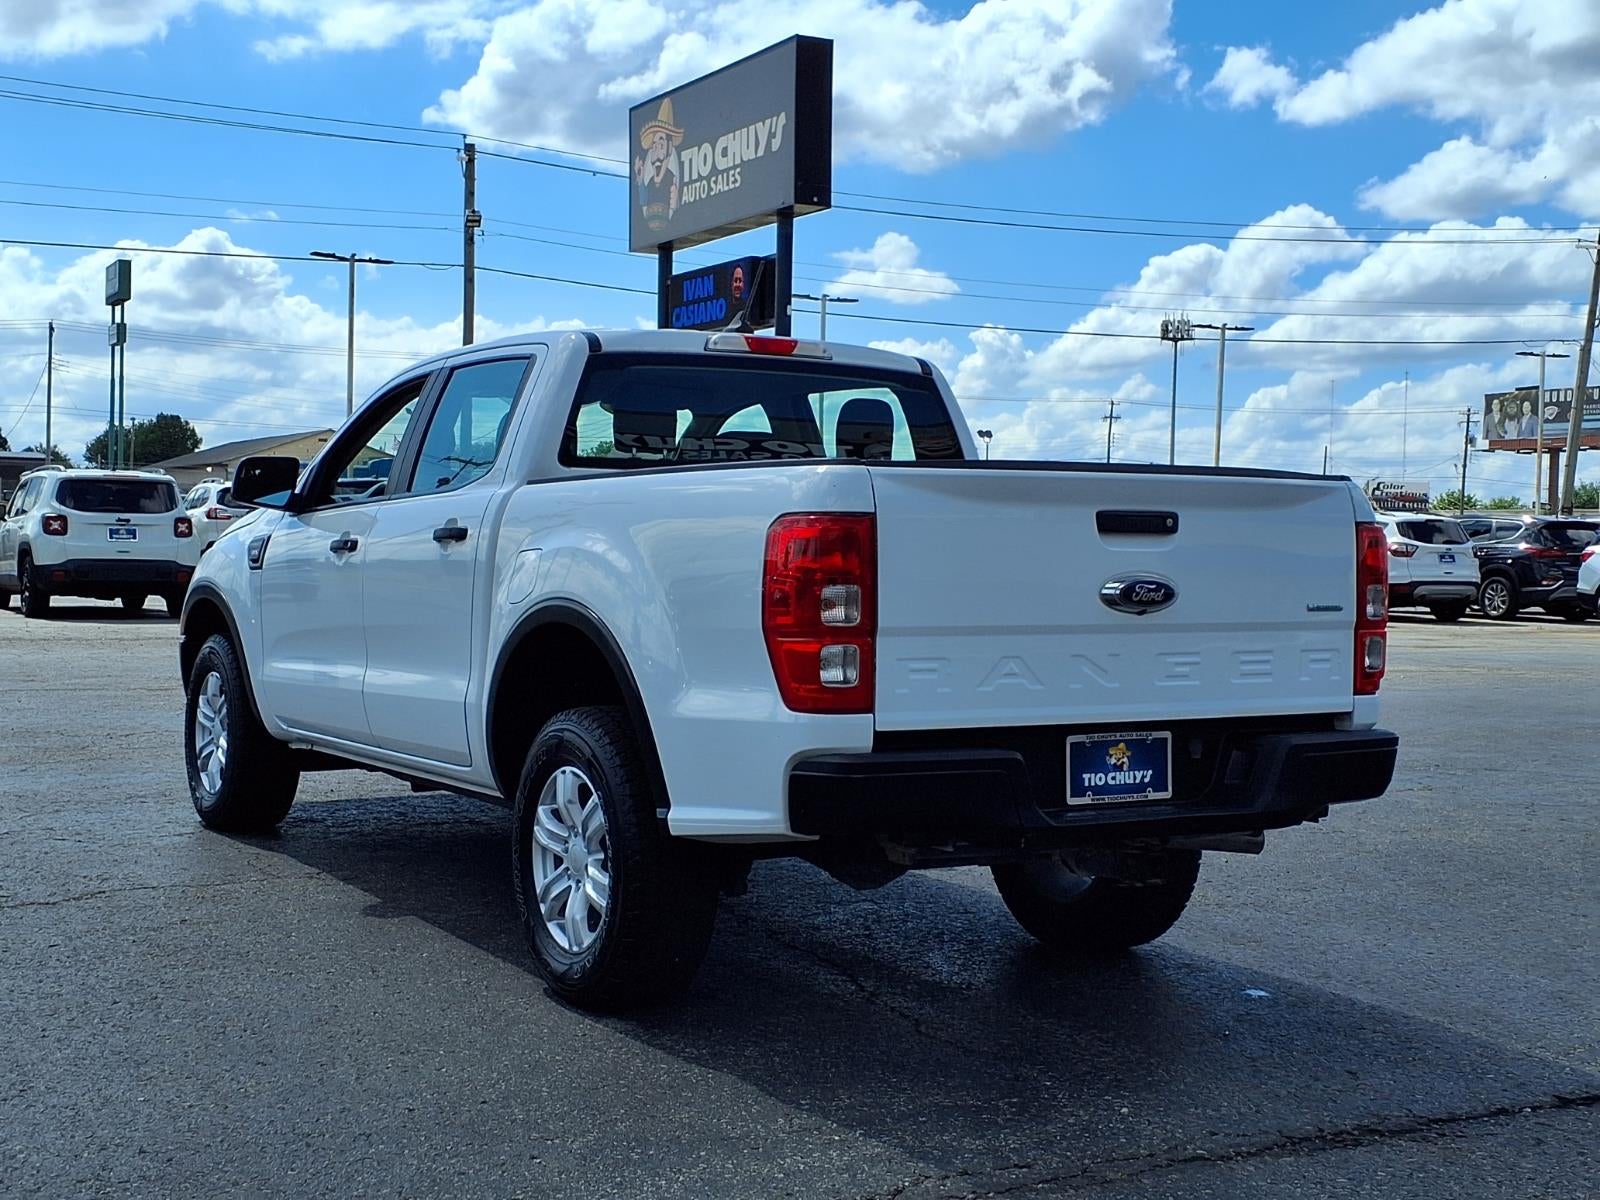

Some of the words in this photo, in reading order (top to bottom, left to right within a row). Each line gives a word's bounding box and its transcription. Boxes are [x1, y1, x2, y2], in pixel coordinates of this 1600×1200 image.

[680, 143, 713, 183] TIO
[714, 111, 786, 171] CHUY'S
[681, 178, 708, 206] AUTO
[710, 168, 741, 197] SALES
[683, 275, 713, 301] IVAN
[672, 298, 726, 328] CASIANO
[1376, 481, 1406, 490] Color
[1132, 583, 1165, 603] Ford
[895, 648, 1342, 694] RANGER
[1082, 772, 1106, 787] TIO
[1107, 769, 1153, 785] CHUY'S
